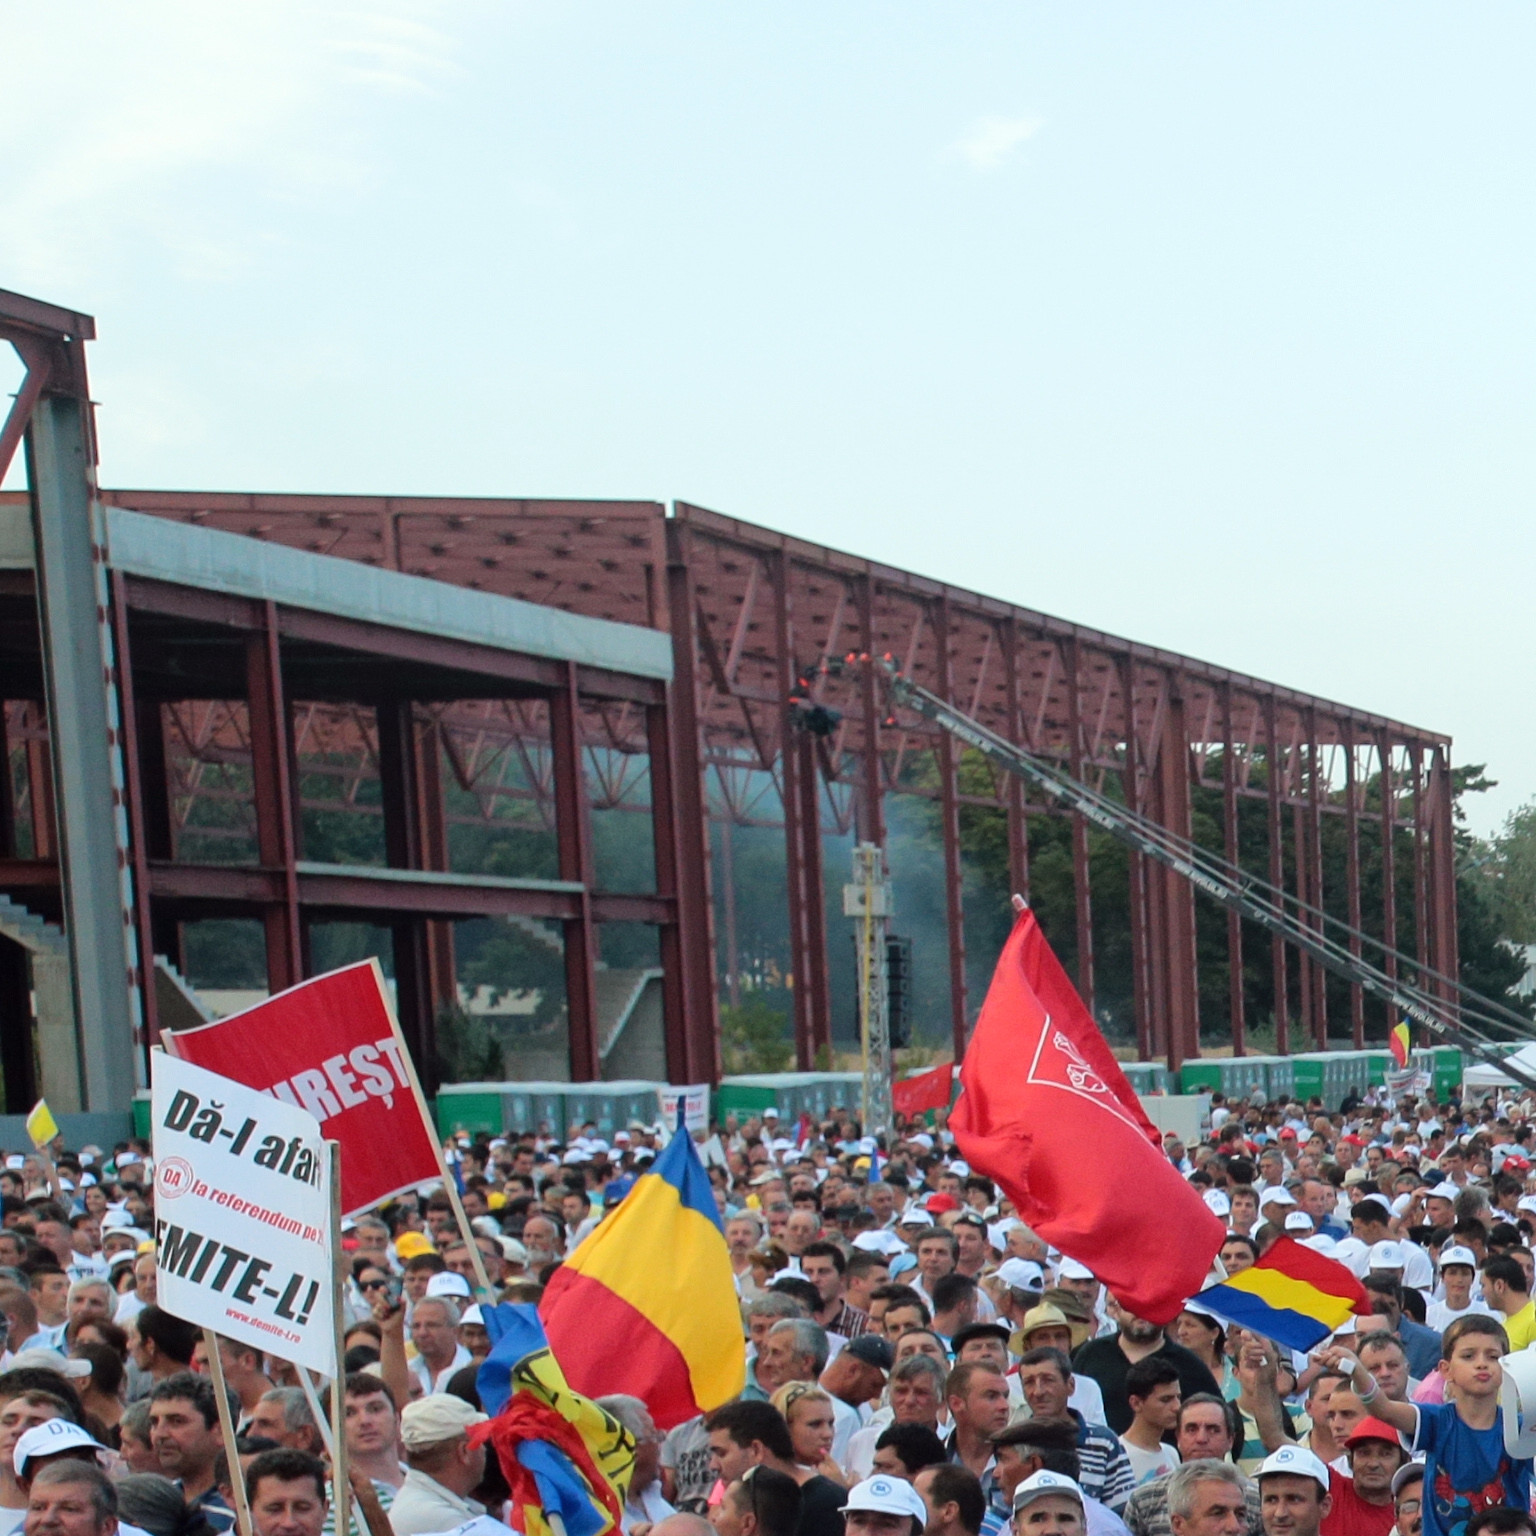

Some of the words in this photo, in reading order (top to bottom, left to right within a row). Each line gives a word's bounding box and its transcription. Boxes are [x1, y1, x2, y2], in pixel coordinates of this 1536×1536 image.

[164, 1168, 182, 1186] DA
[192, 1178, 208, 1198] la
[208, 1188, 303, 1236] referendum
[302, 1225, 317, 1241] pe
